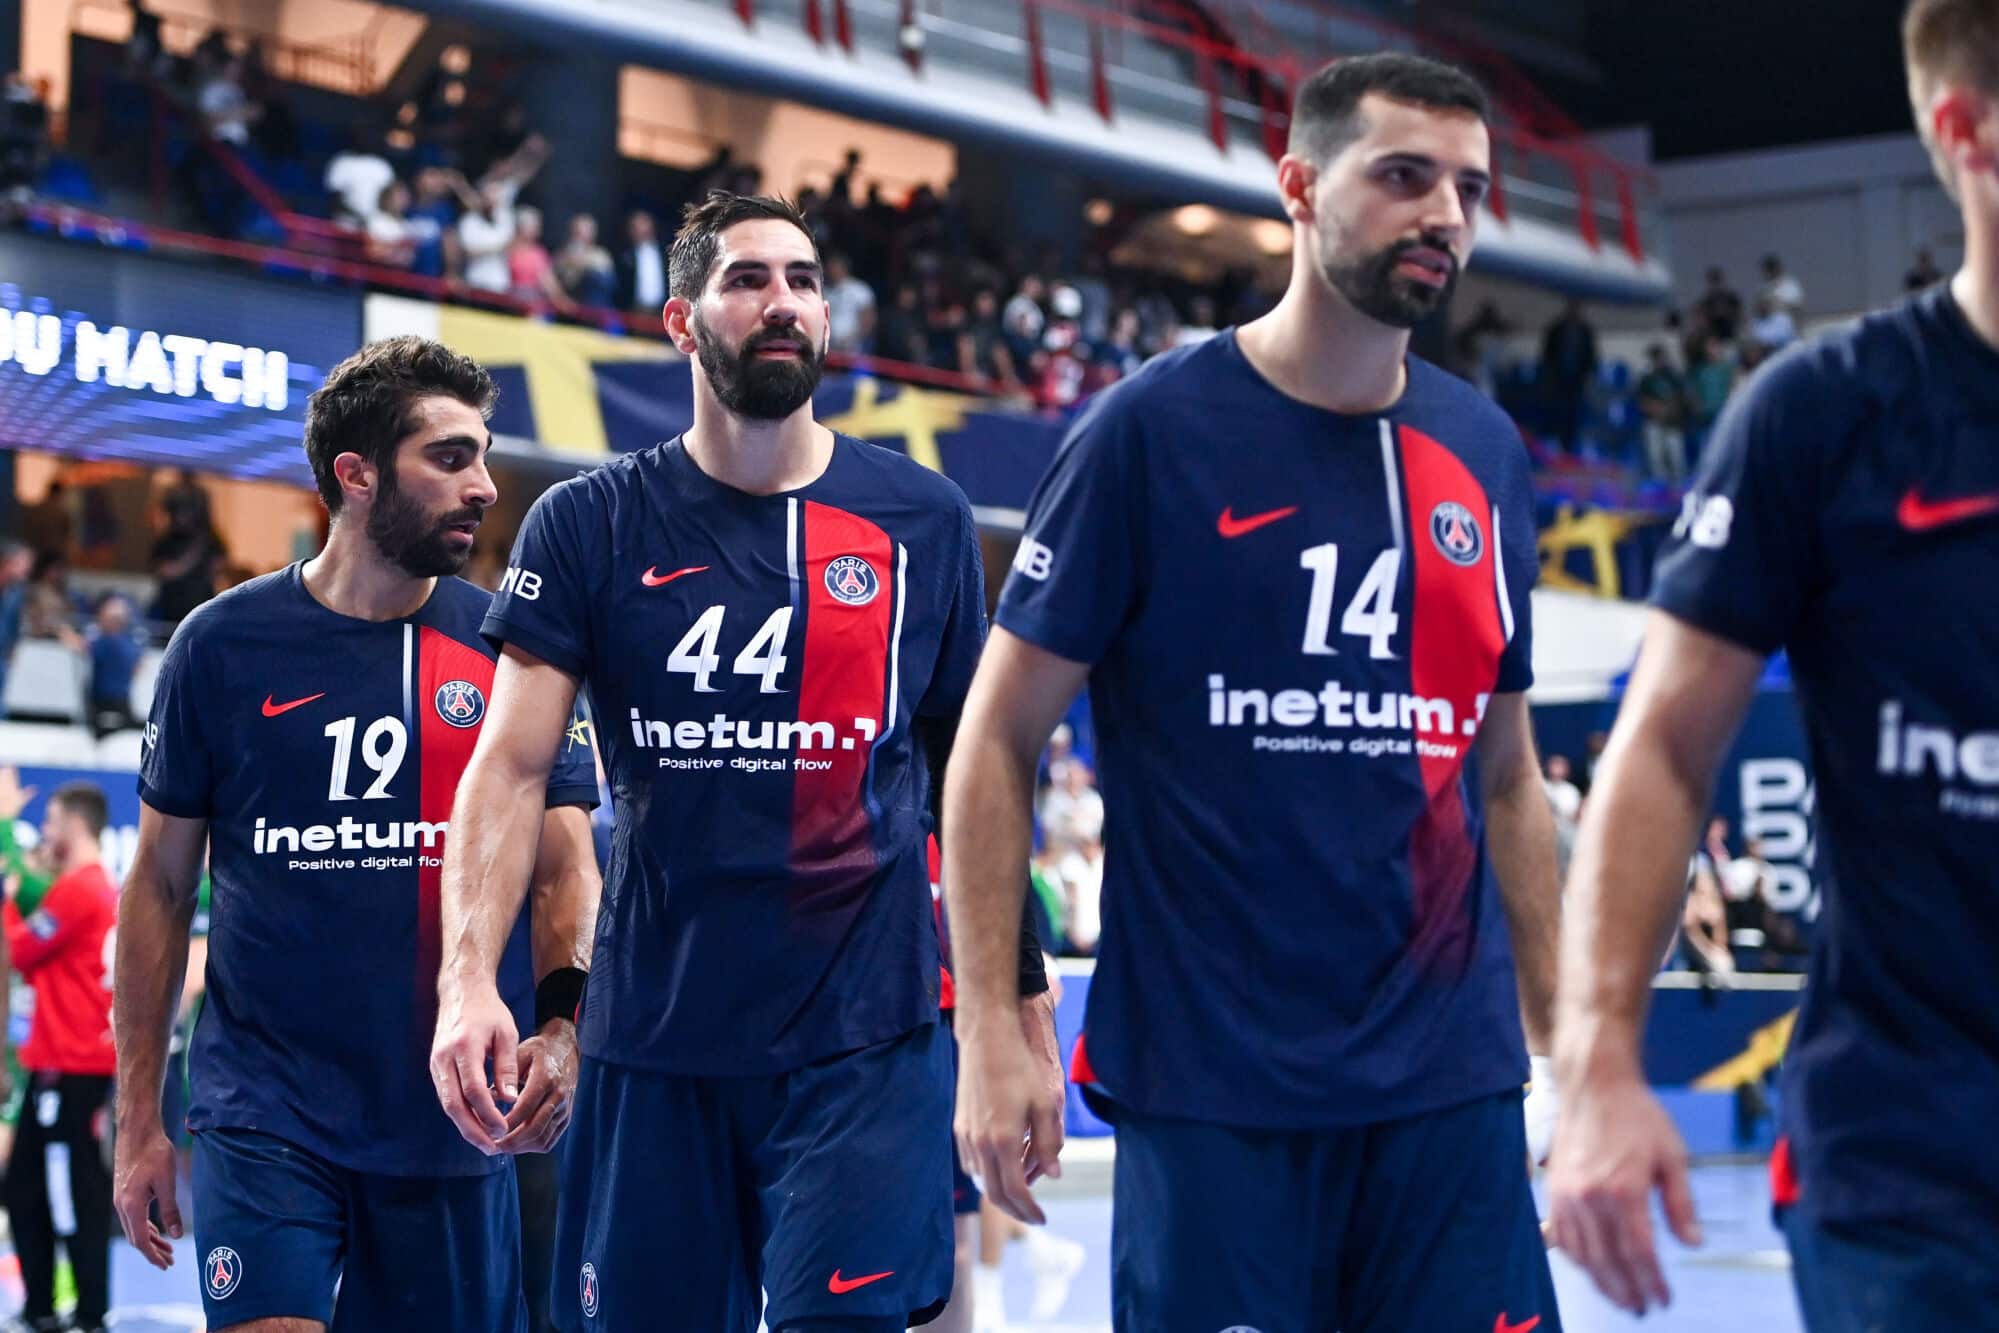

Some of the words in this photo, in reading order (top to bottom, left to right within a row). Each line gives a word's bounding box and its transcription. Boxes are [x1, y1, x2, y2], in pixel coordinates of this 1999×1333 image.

[0, 307, 61, 375] U
[75, 320, 288, 411] MATCH
[832, 559, 868, 572] PARIS
[499, 566, 543, 600] NB
[1301, 543, 1400, 659] 14
[666, 605, 793, 693] 44
[442, 683, 477, 695] PARIS
[324, 715, 407, 801] 19
[1253, 735, 1344, 753] Positive
[1350, 737, 1411, 757] digital
[1415, 739, 1457, 758] flow
[659, 758, 724, 769] Positive
[730, 757, 786, 772] digital
[793, 758, 832, 770] flow
[254, 816, 449, 854] inetum
[289, 858, 355, 870] Positive
[361, 856, 412, 870] digital
[418, 855, 444, 867] flo
[208, 1249, 233, 1265] PARIS
